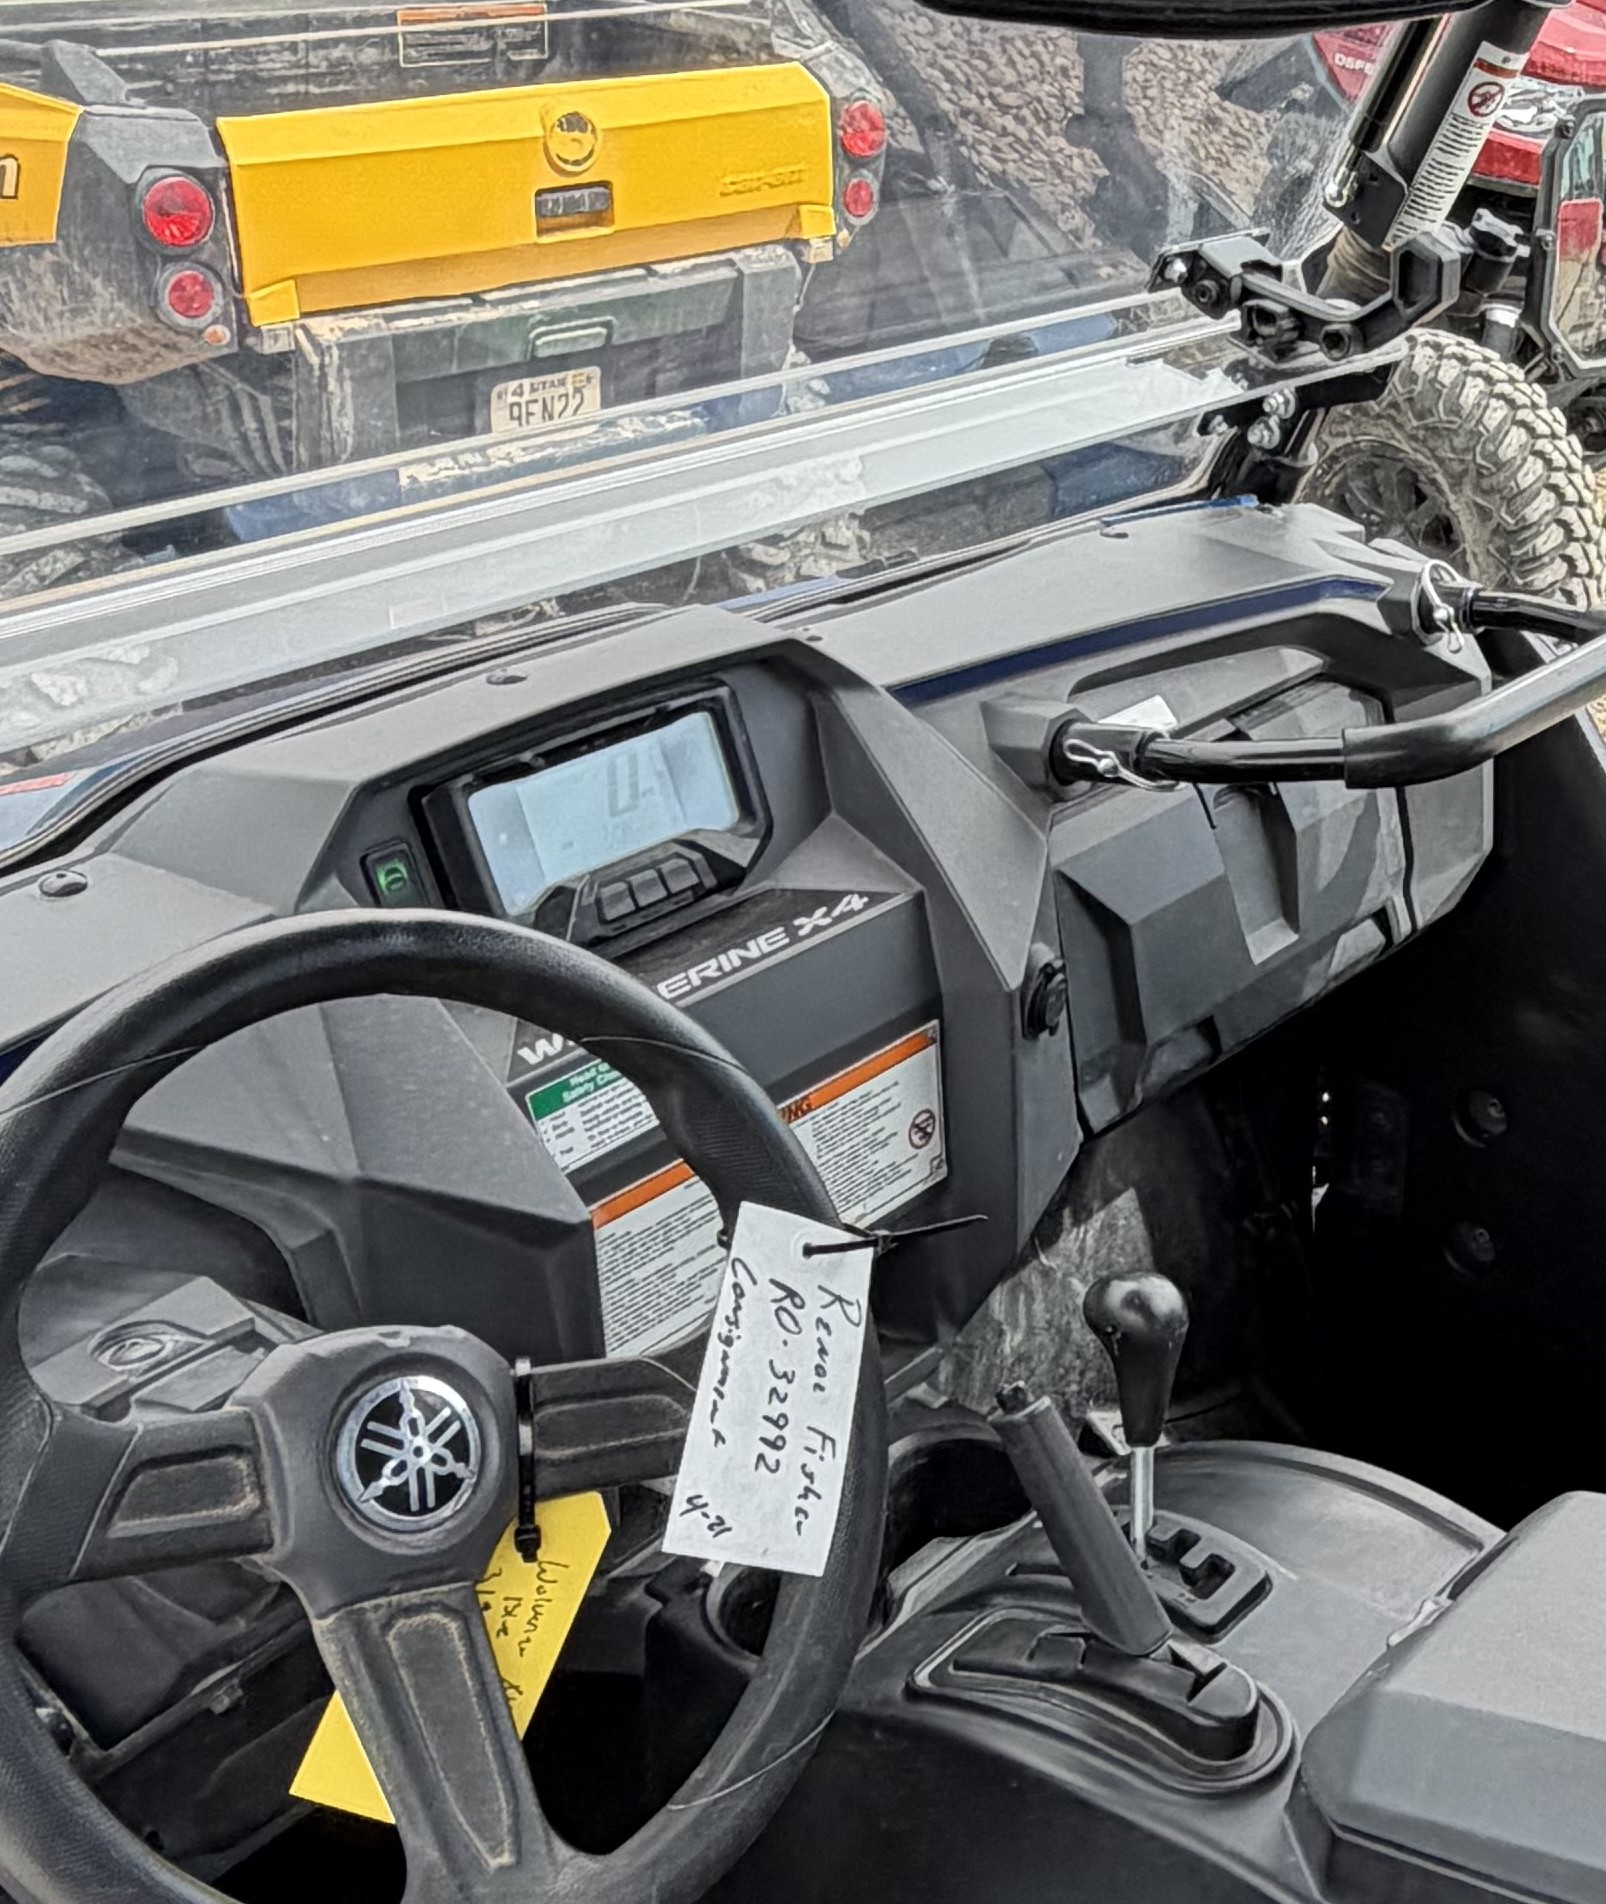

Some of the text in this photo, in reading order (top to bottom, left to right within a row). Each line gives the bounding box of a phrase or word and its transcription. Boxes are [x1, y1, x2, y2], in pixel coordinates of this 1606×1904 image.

[517, 893, 870, 1066] WERINE X4
[754, 1359, 796, 1474] 32992
[679, 1494, 733, 1538] 4-21
[794, 1425, 837, 1536] Fisher
